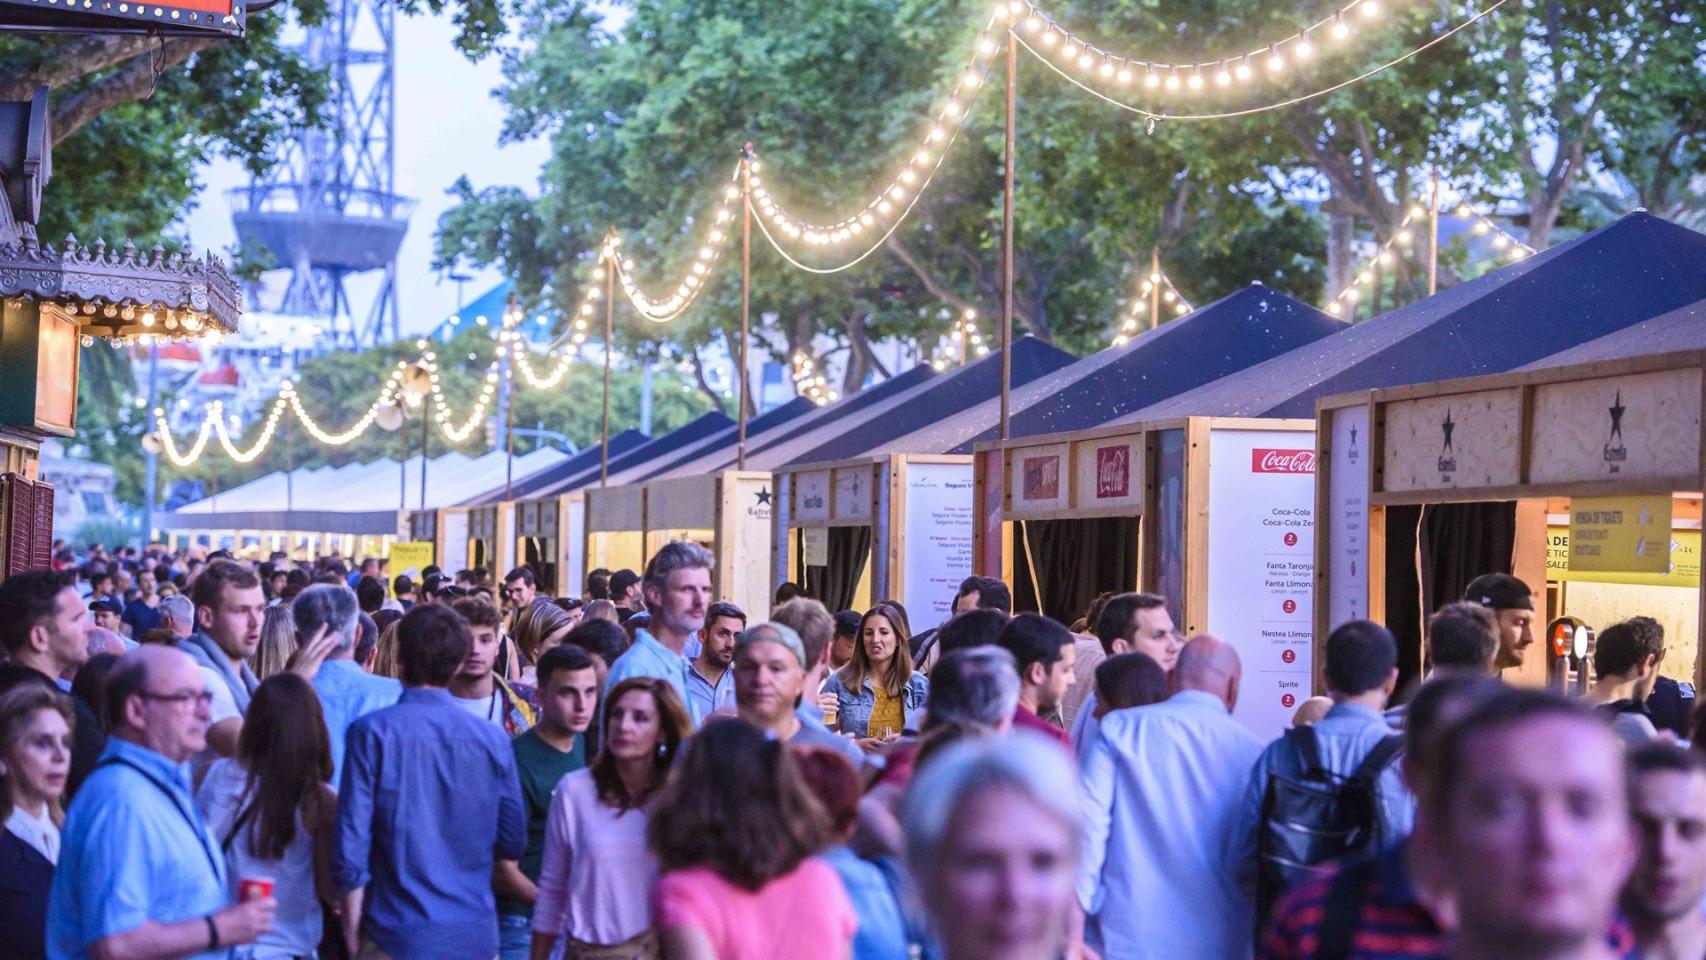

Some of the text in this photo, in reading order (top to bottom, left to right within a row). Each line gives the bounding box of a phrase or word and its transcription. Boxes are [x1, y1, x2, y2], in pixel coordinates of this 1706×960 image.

[1272, 507, 1310, 516] Coca-Cola
[1263, 518, 1301, 526] Coca-Cola
[1553, 536, 1568, 546] DE
[1546, 560, 1567, 569] SALE
[1278, 680, 1299, 688] Sprite
